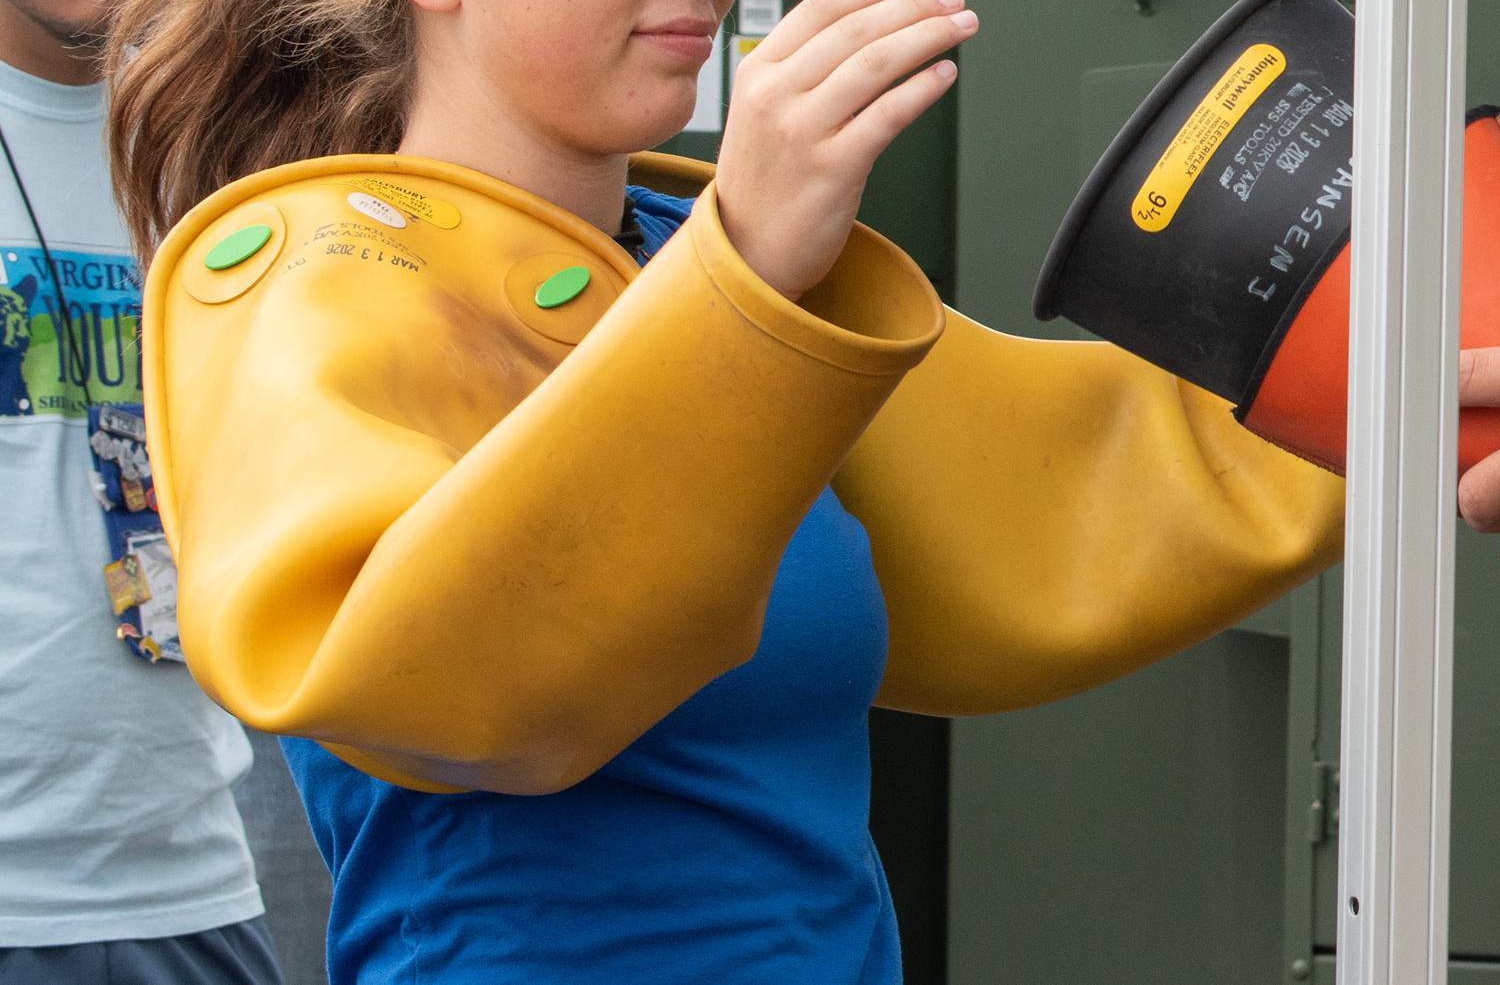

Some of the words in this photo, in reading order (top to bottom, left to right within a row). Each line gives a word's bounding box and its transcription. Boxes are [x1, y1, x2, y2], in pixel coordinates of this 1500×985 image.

[1215, 66, 1245, 101] SALISBURY
[1222, 54, 1278, 111] Honeywell
[1267, 99, 1291, 123] SFS
[1277, 94, 1323, 137] TESTED
[1322, 99, 1353, 127] MAR
[1300, 131, 1320, 148] 3
[1310, 122, 1329, 137] 1
[1185, 119, 1230, 178] ELECTRIFLEX
[1234, 123, 1273, 165] TOOLS
[1252, 136, 1282, 173] 20KV
[1276, 141, 1309, 174] 2026
[325, 243, 356, 256] 2026
[360, 248, 370, 260] 3
[377, 251, 384, 262] 1
[391, 254, 419, 272] MAR
